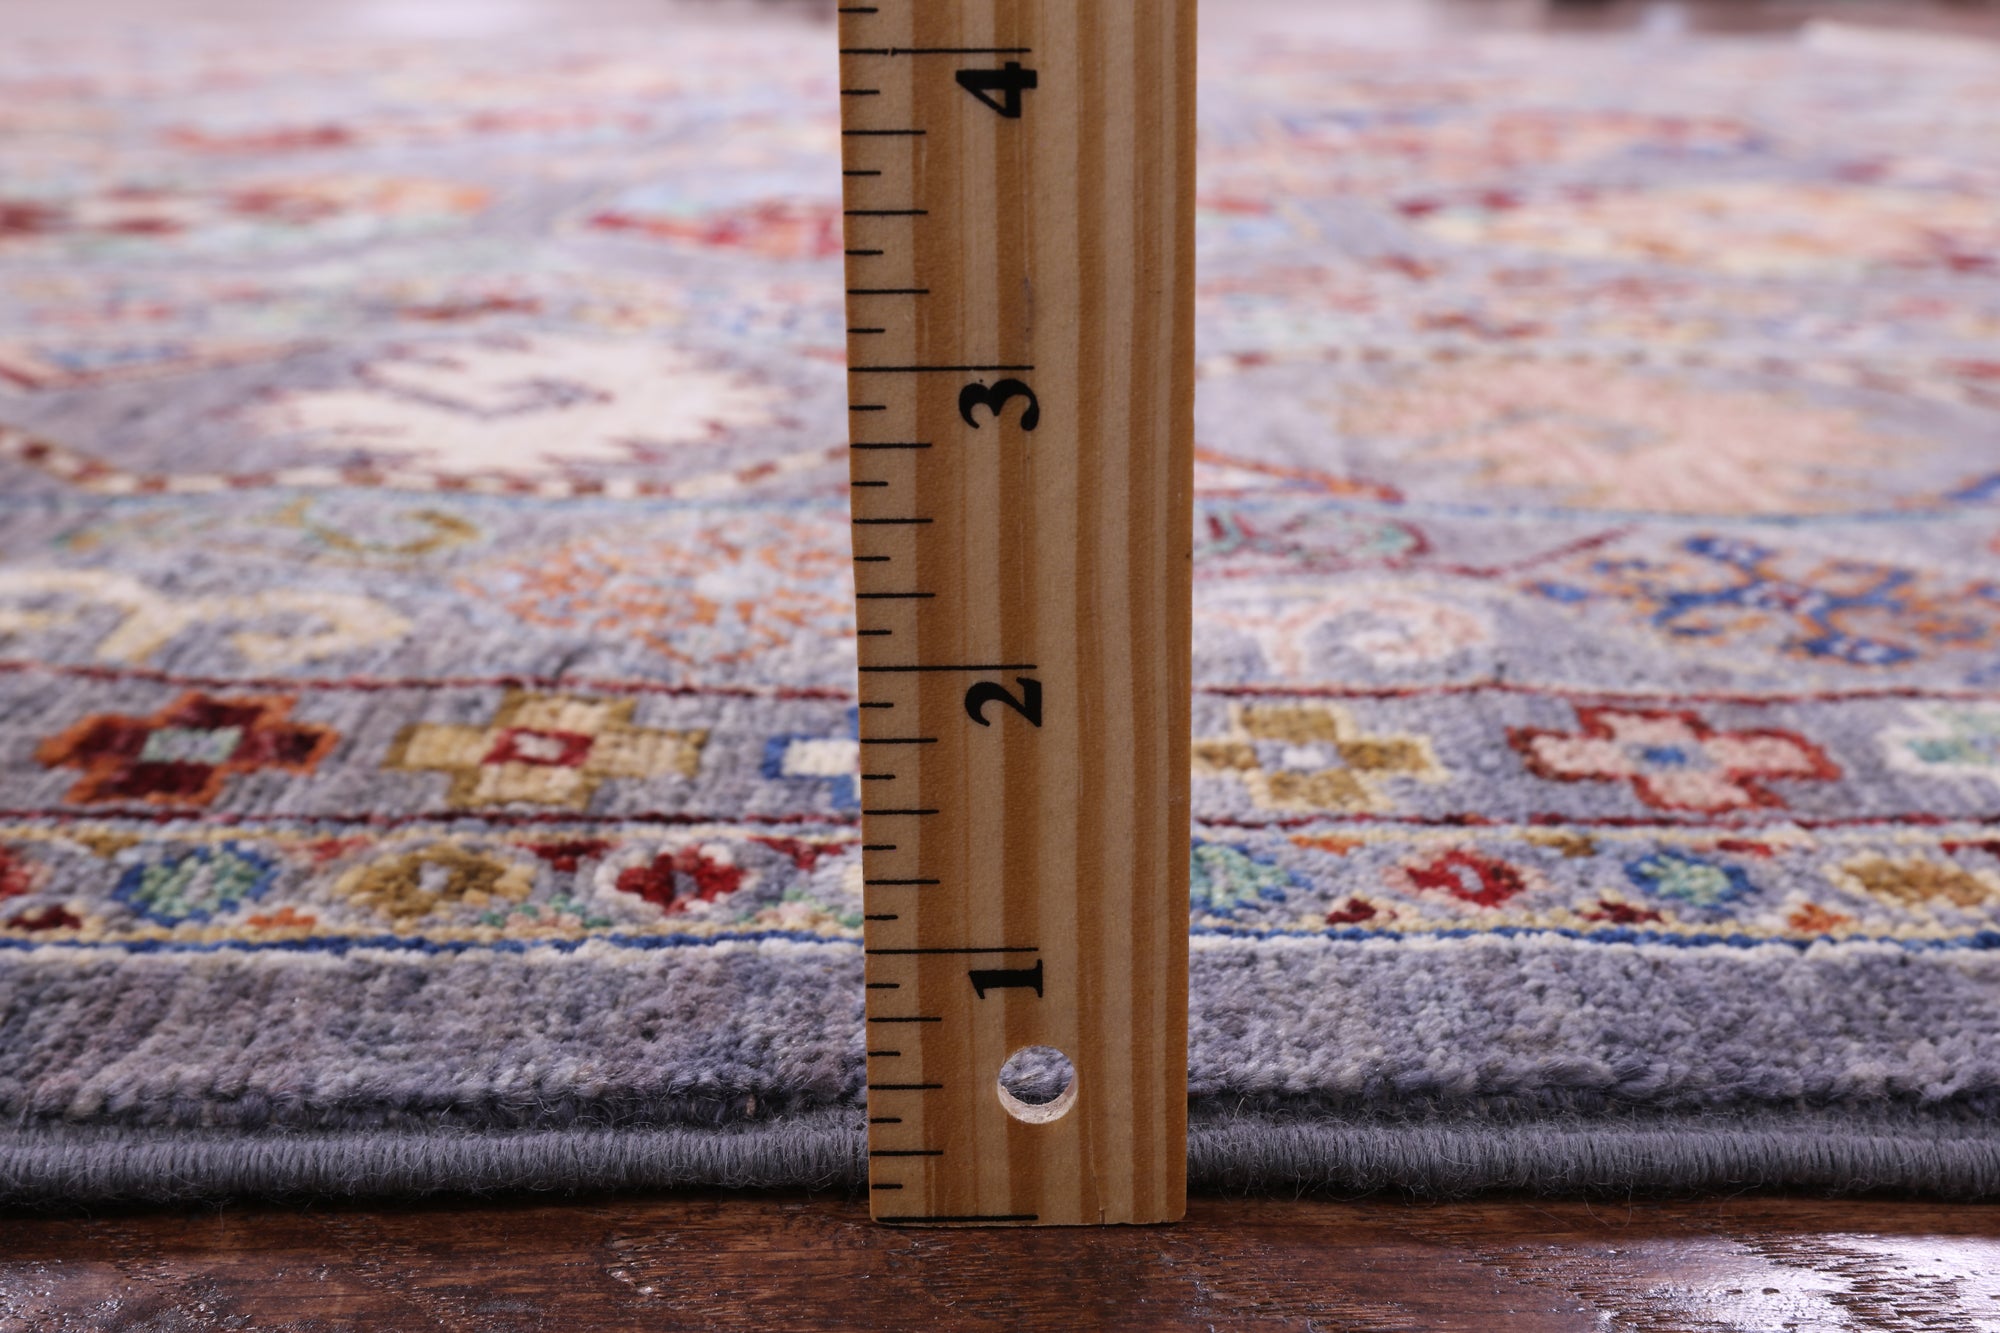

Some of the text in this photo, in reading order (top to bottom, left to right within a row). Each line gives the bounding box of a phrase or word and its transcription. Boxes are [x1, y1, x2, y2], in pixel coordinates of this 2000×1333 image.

[955, 61, 1039, 120] 4
[958, 378, 1041, 433] 3
[964, 675, 1043, 729] 2
[968, 957, 1044, 1000] 1
